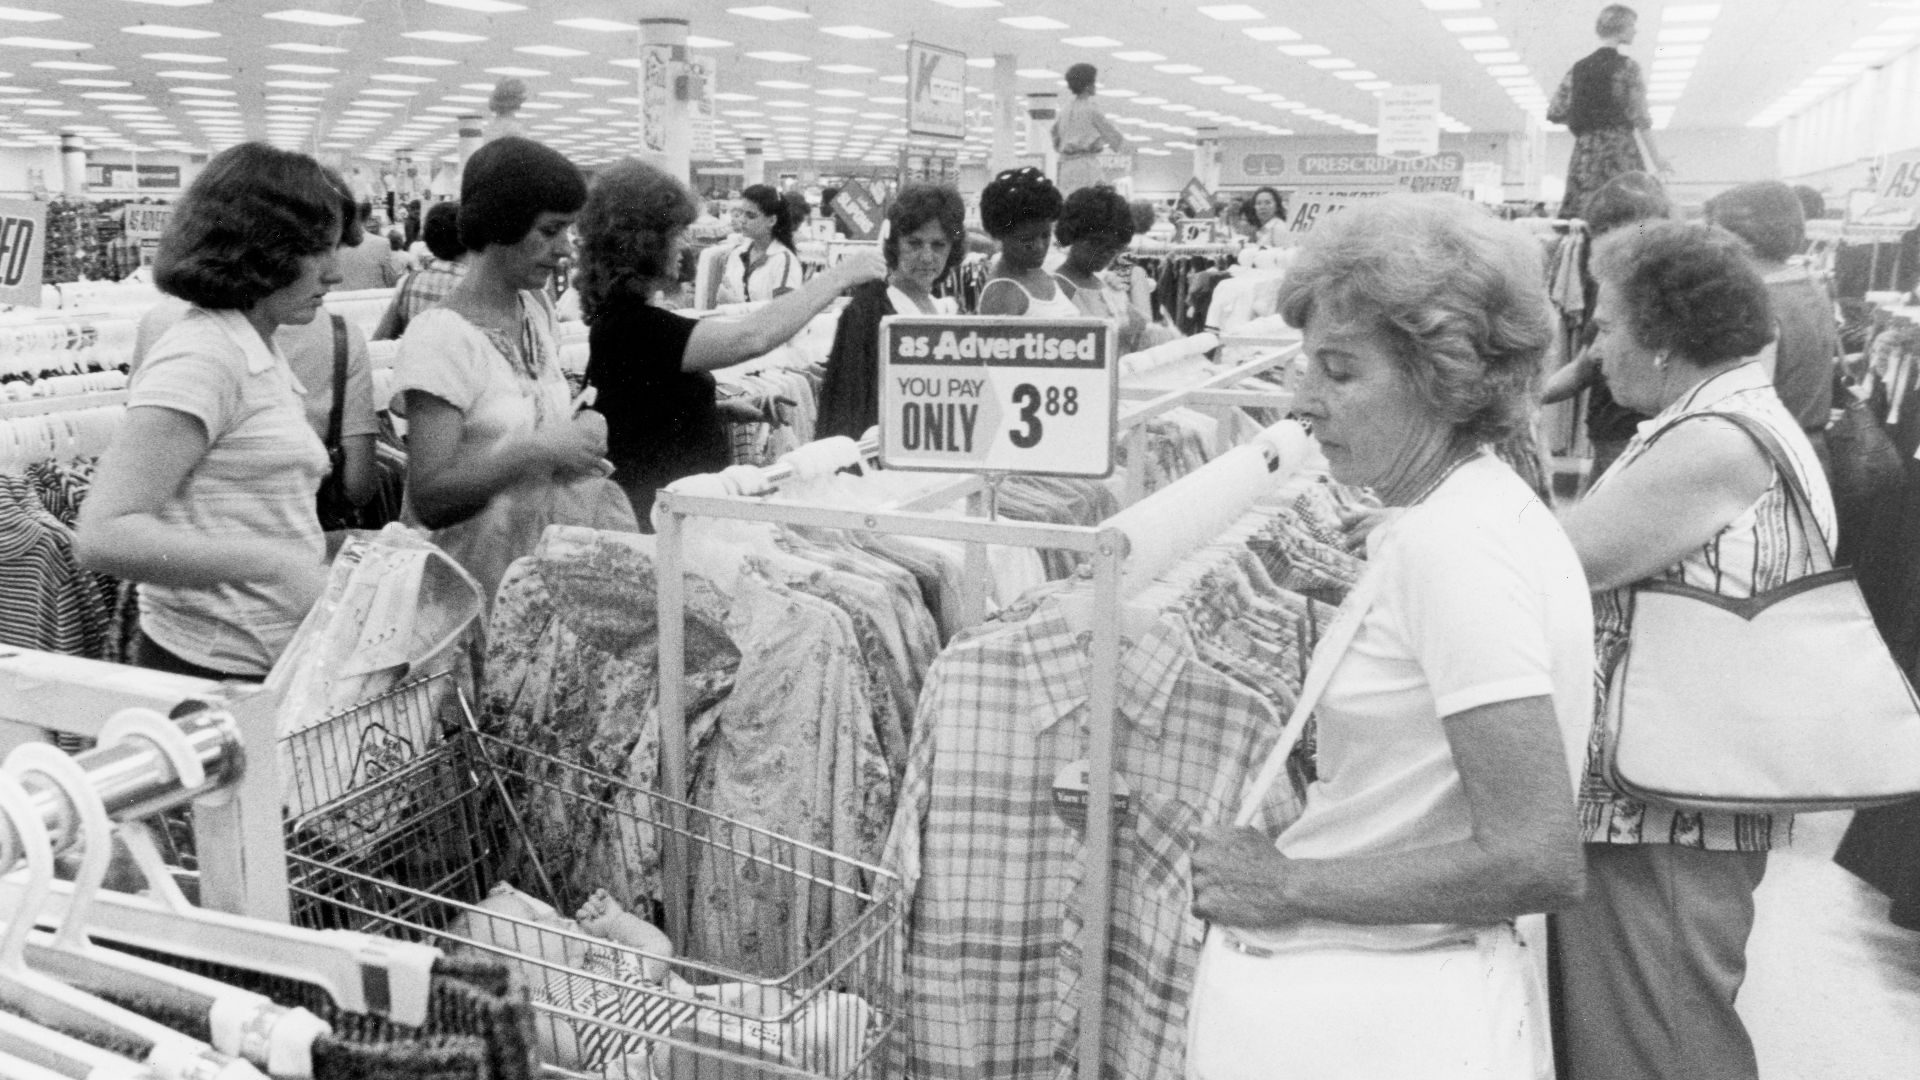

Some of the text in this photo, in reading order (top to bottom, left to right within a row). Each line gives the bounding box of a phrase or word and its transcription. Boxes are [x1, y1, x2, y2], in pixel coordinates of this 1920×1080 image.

[914, 52, 941, 102] K
[1290, 202, 1320, 233] AS
[898, 330, 1096, 361] as Advertised
[897, 377, 985, 398] YOU PAY
[902, 401, 979, 453] ONLY
